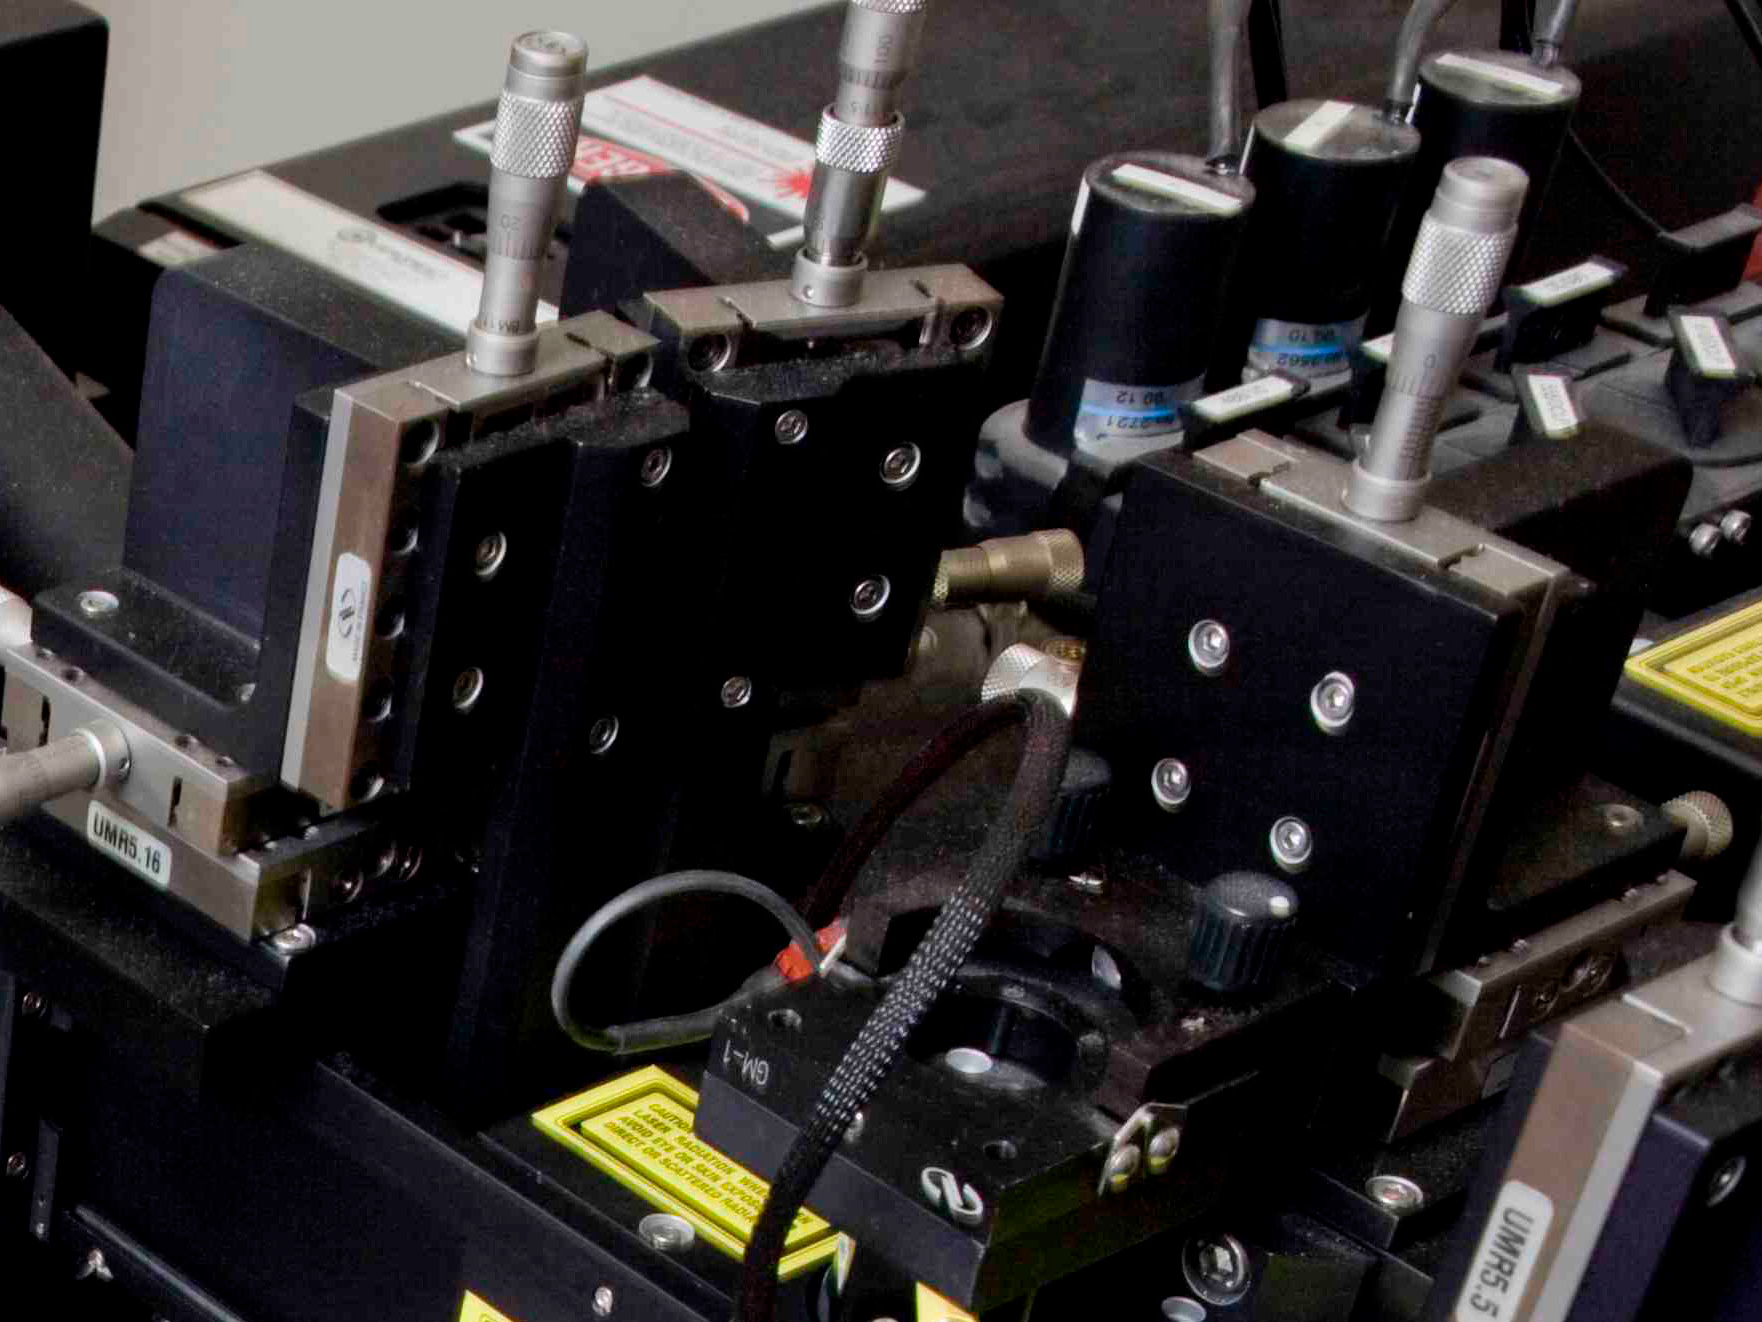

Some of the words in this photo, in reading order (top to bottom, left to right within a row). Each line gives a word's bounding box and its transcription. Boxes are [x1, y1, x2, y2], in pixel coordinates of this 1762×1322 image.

[93, 811, 162, 874] UMR5.16
[723, 1039, 769, 1085] GM-1
[614, 1116, 654, 1138] AVOID
[694, 1163, 722, 1183] SKIN
[633, 1109, 671, 1134] LASER
[674, 1135, 735, 1176] RADIATION
[647, 1103, 692, 1132] CAUTIO
[604, 1120, 645, 1146] DIRECT
[659, 1157, 722, 1199] SCATTERED
[1470, 1206, 1534, 1318] UMR5.5
